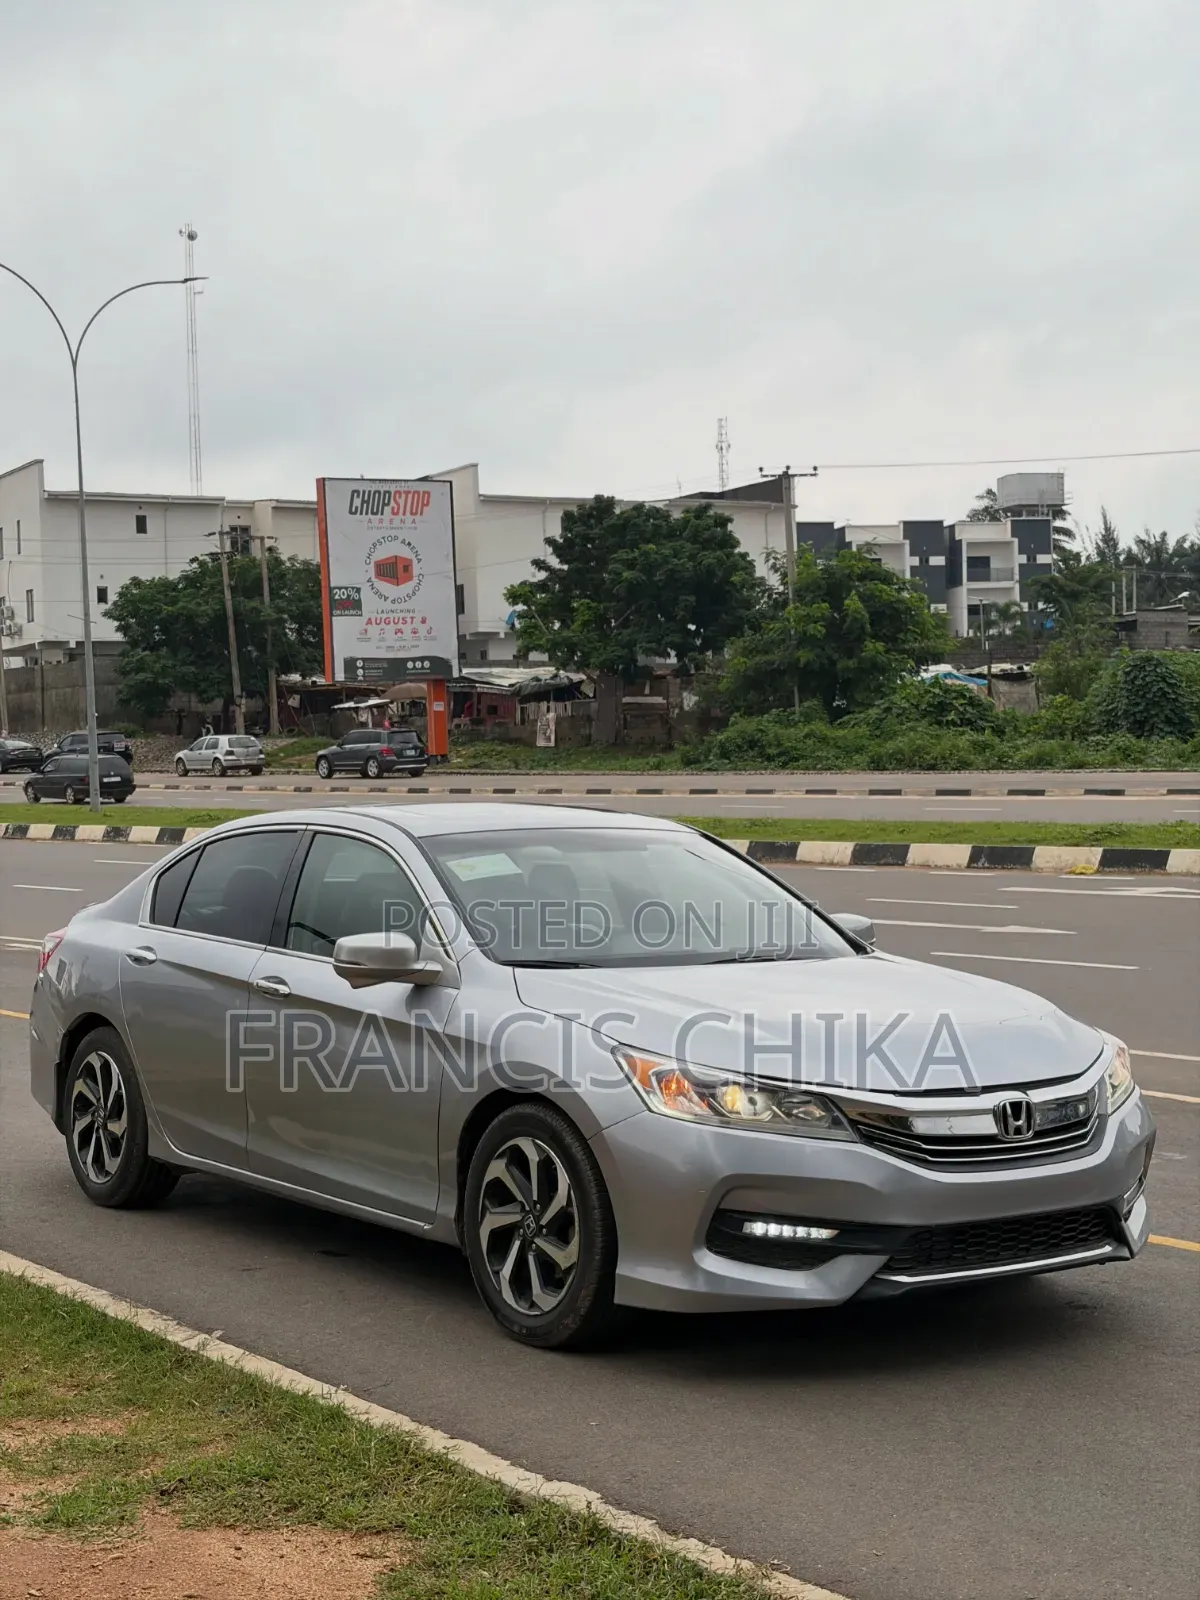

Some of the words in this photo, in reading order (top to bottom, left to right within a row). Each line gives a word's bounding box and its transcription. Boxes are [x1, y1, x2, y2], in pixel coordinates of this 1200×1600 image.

[348, 489, 431, 516] CHOPSTOP
[333, 587, 360, 600] 20%
[365, 616, 416, 626] AUGUST
[420, 616, 428, 625] 8
